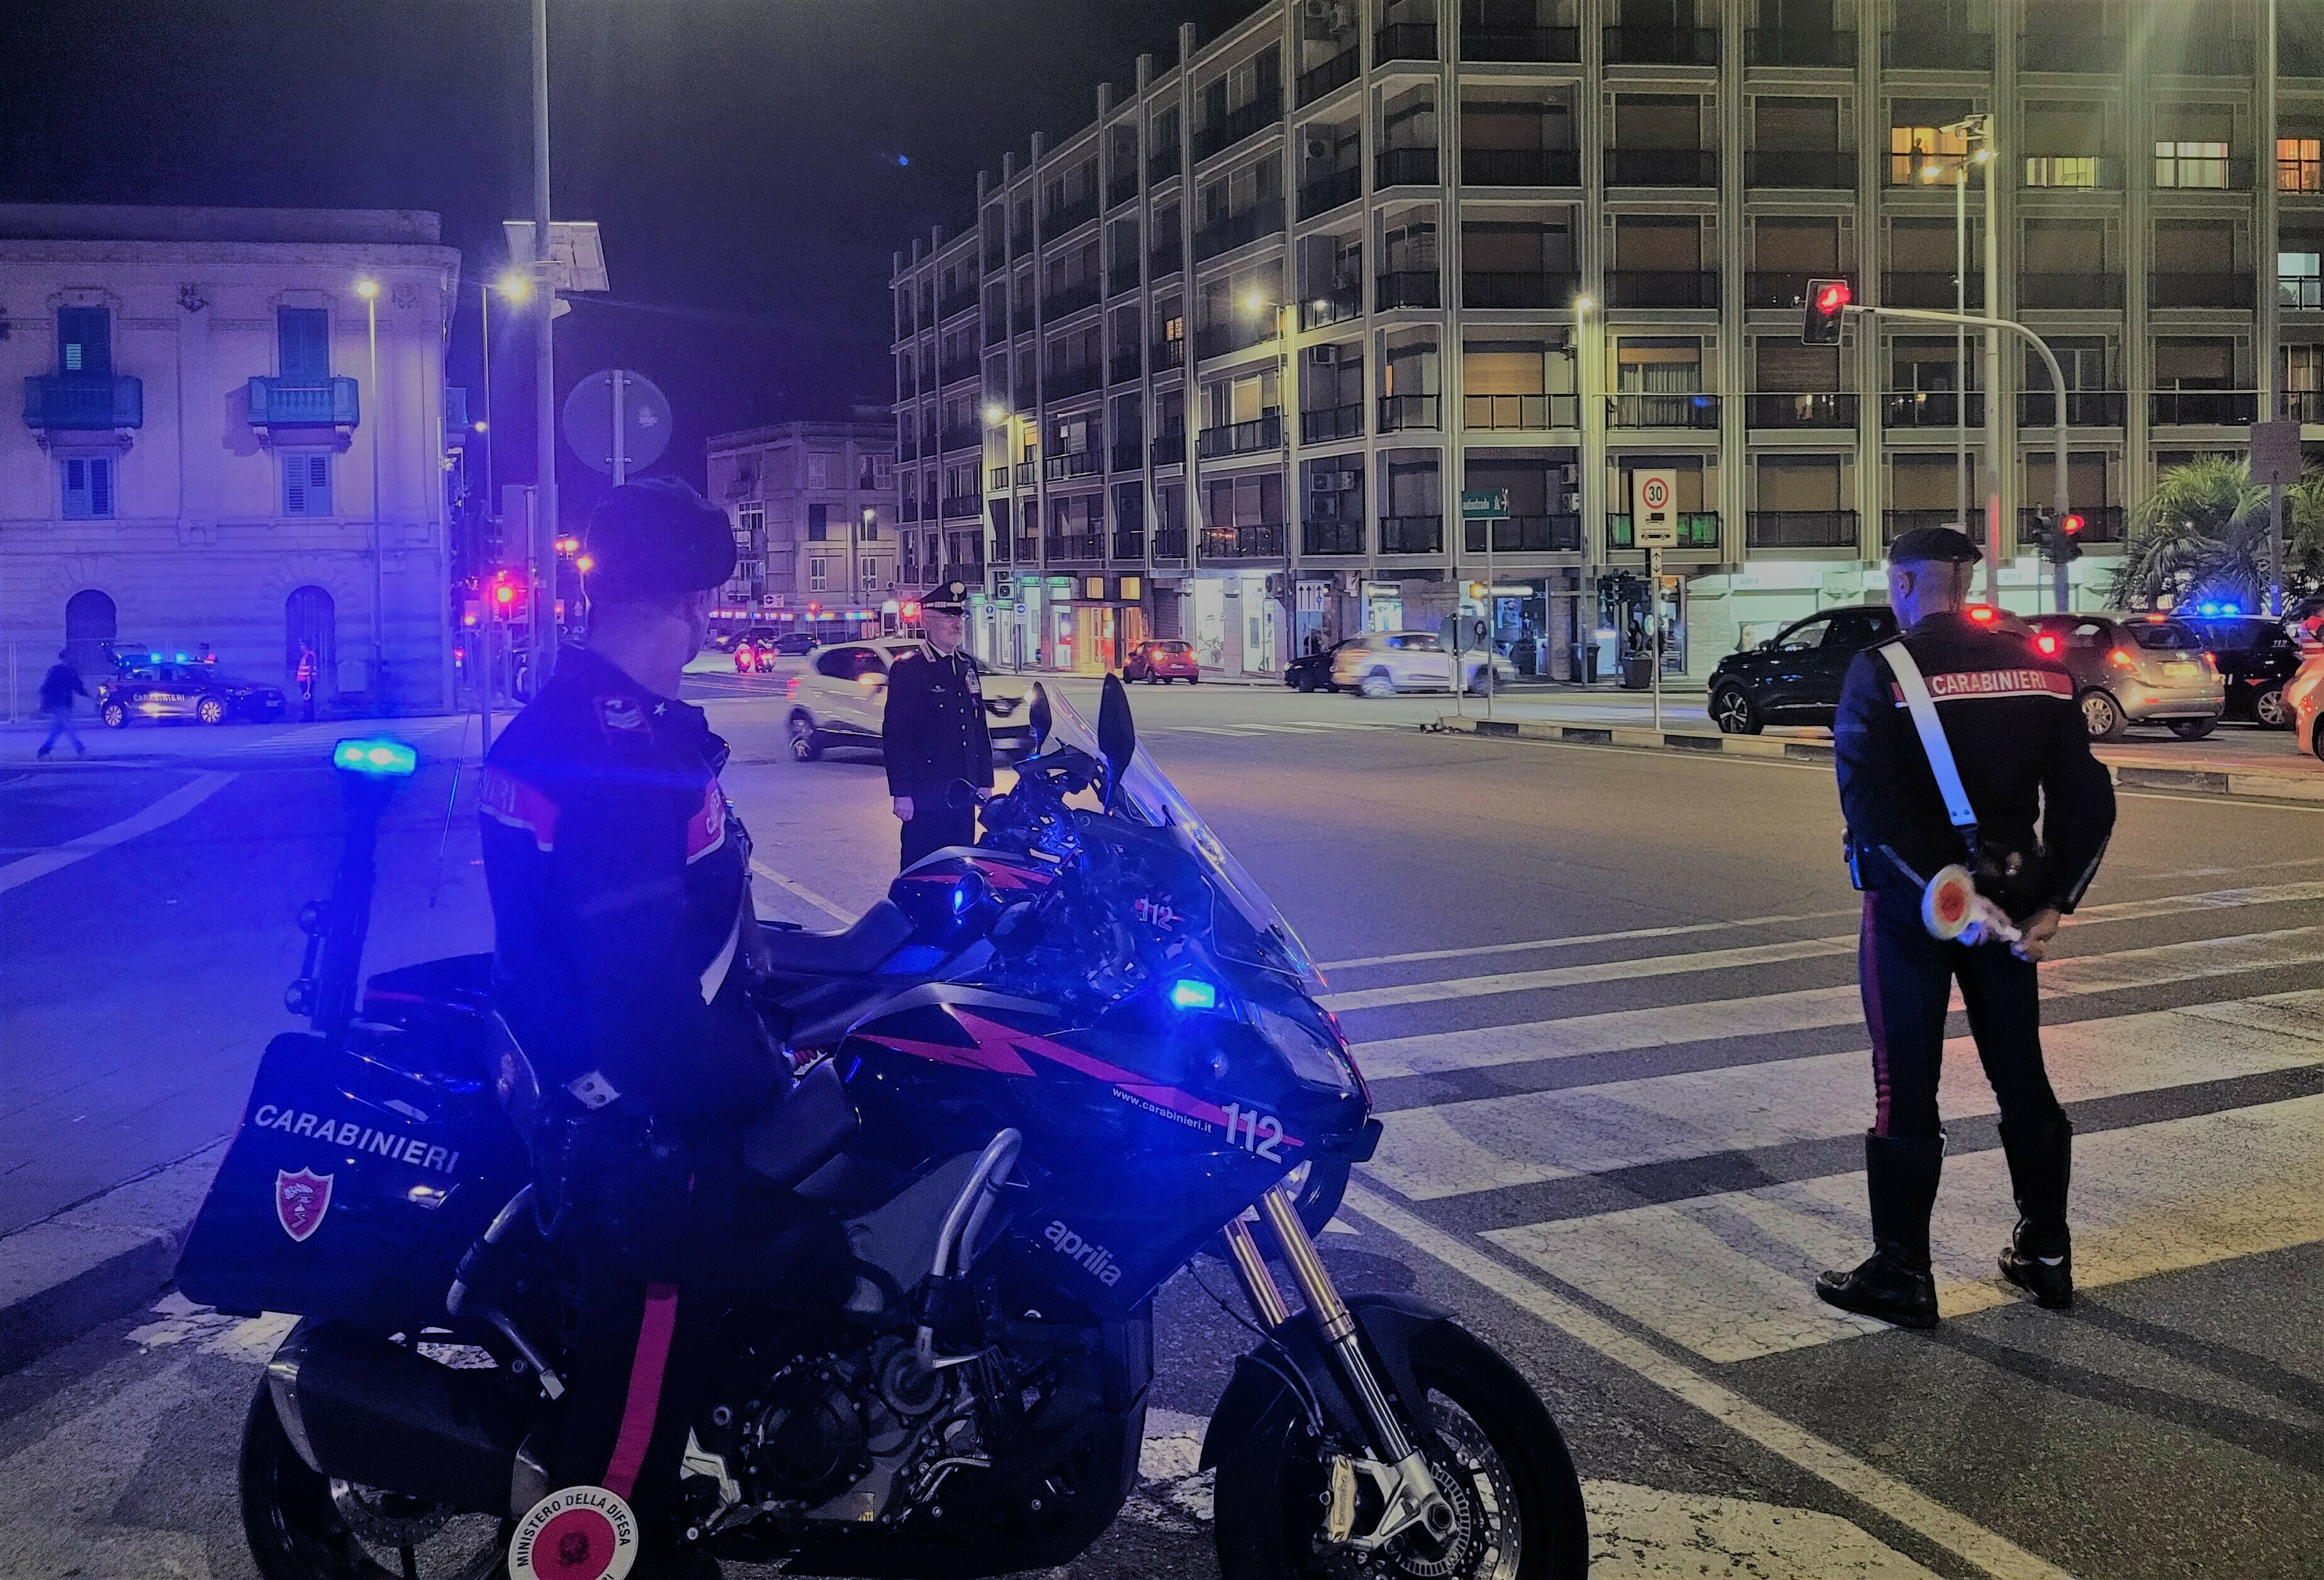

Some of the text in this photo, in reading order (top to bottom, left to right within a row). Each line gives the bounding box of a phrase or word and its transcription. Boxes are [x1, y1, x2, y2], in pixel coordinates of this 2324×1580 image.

[1648, 486, 1663, 501] 30
[2272, 639, 2288, 648] 112
[133, 693, 186, 702] CARABINIERI
[1931, 670, 2048, 695] CARABINIERI
[1140, 898, 1173, 932] 112
[1112, 1087, 1212, 1133] www.carabinieri.it
[254, 1104, 460, 1174] CARABINIERI
[1221, 1102, 1284, 1164] 112
[1045, 1220, 1121, 1287] aprilia
[517, 1493, 631, 1567] MINISTERO DELLA DIFESA
